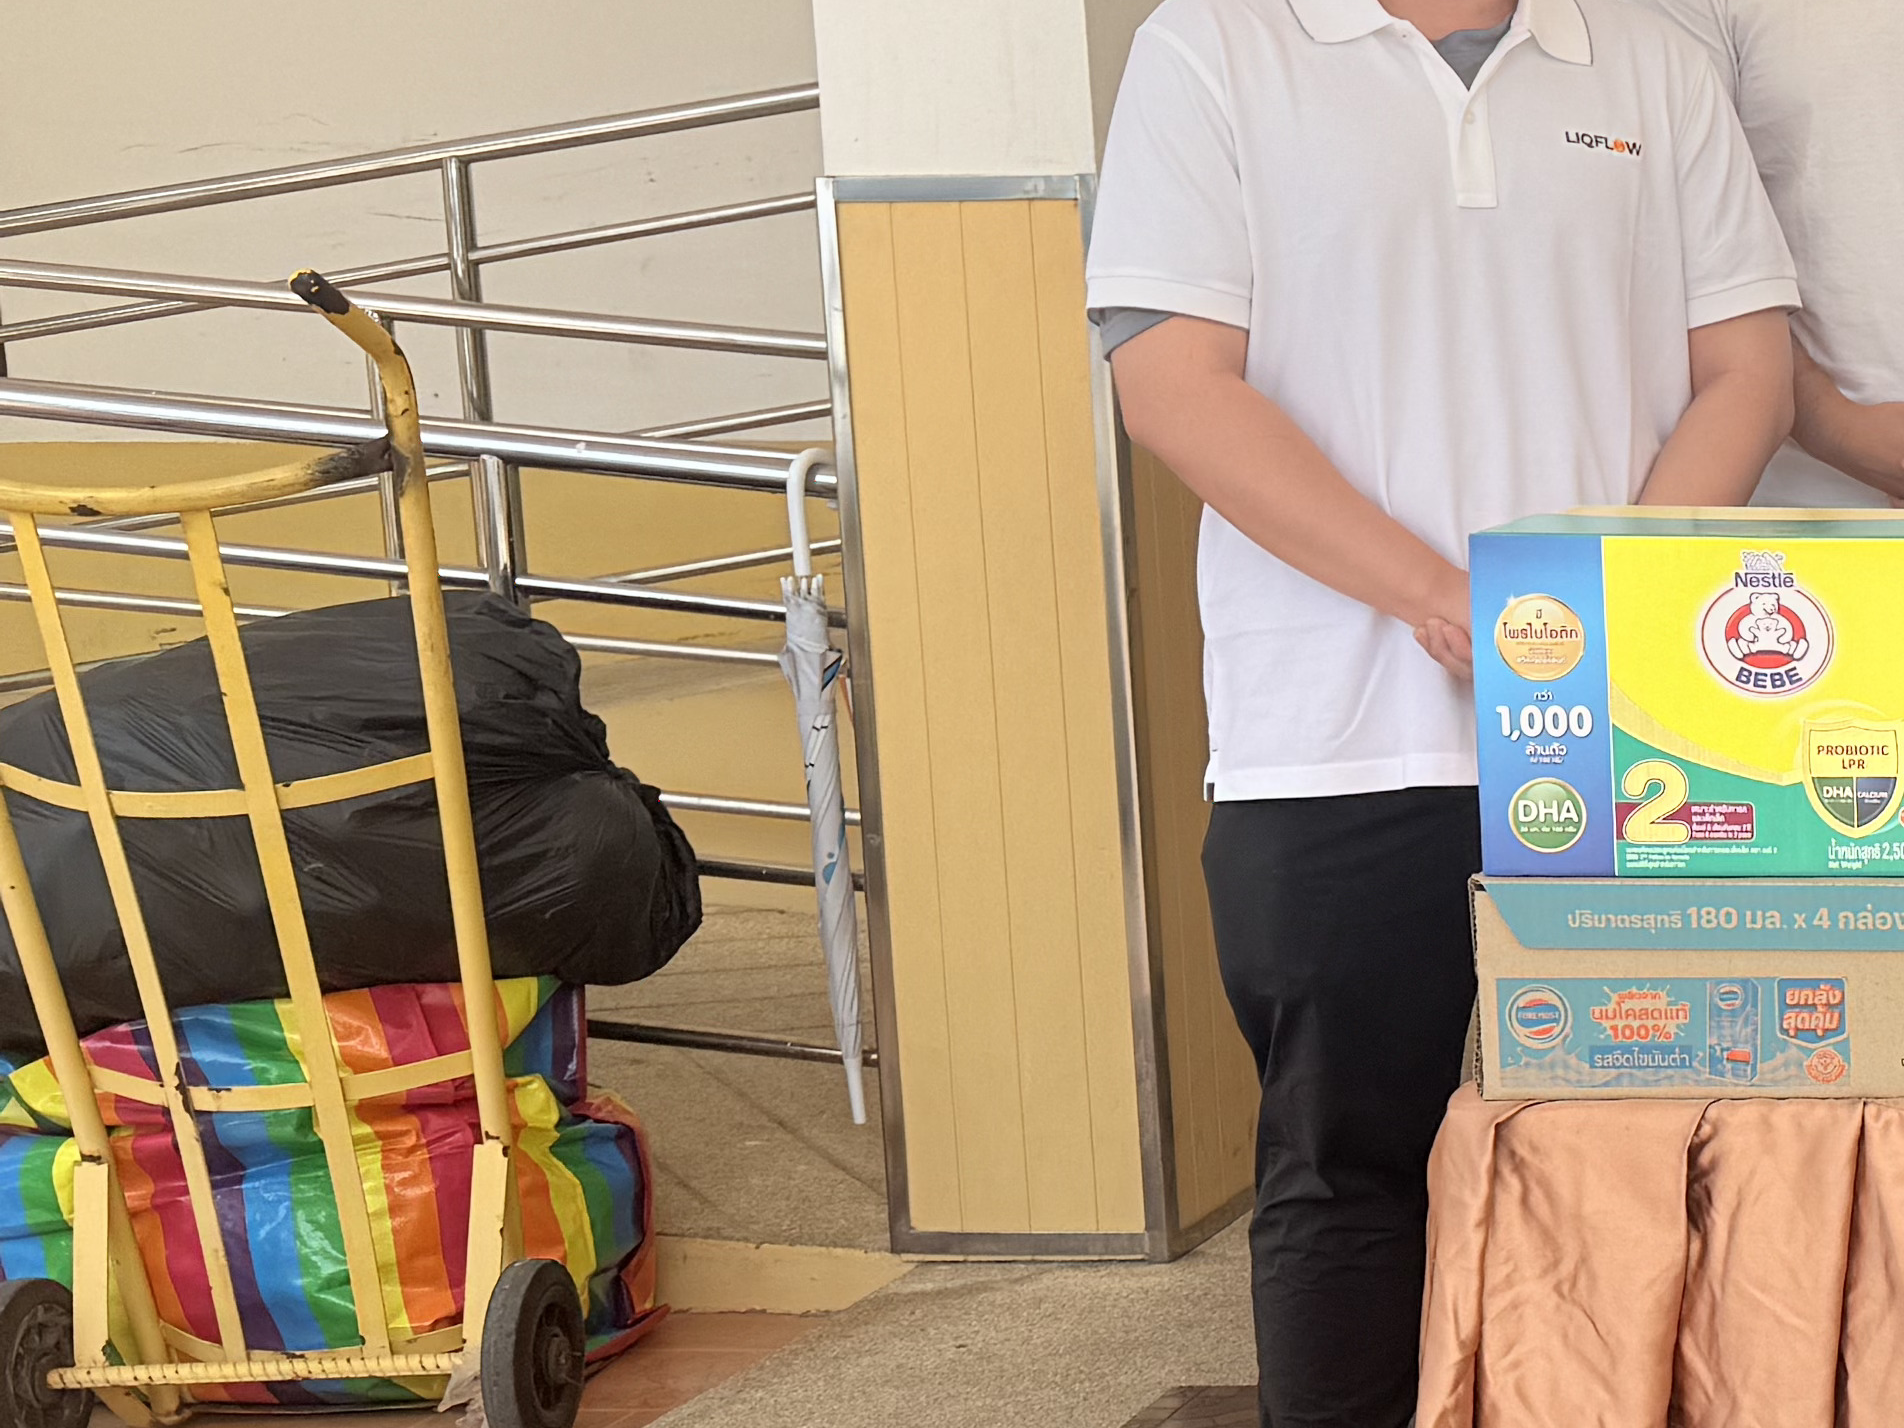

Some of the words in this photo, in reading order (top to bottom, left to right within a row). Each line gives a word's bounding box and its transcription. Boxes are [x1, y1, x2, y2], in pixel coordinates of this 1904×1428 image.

[1564, 129, 1642, 158] LIQFLOW
[1736, 667, 1803, 689] BEBE
[1496, 705, 1593, 741] 1,000
[1817, 745, 1889, 756] PROBIOTIC
[1842, 759, 1865, 769] LPR
[1518, 800, 1578, 822] DHA
[1624, 760, 1689, 843] 2
[1568, 909, 1682, 934] ปริมาตรสุทธิ
[1687, 908, 1738, 929] 180
[1745, 911, 1788, 930] มล.
[1794, 913, 1806, 929] x
[1815, 910, 1831, 929] 4
[1786, 986, 1842, 1007] ยกลัง
[1591, 1002, 1690, 1023] นมโคสดแท้
[1609, 1023, 1673, 1042] 100%
[1593, 1048, 1690, 1067] รสจืดไขมันต่ำ
